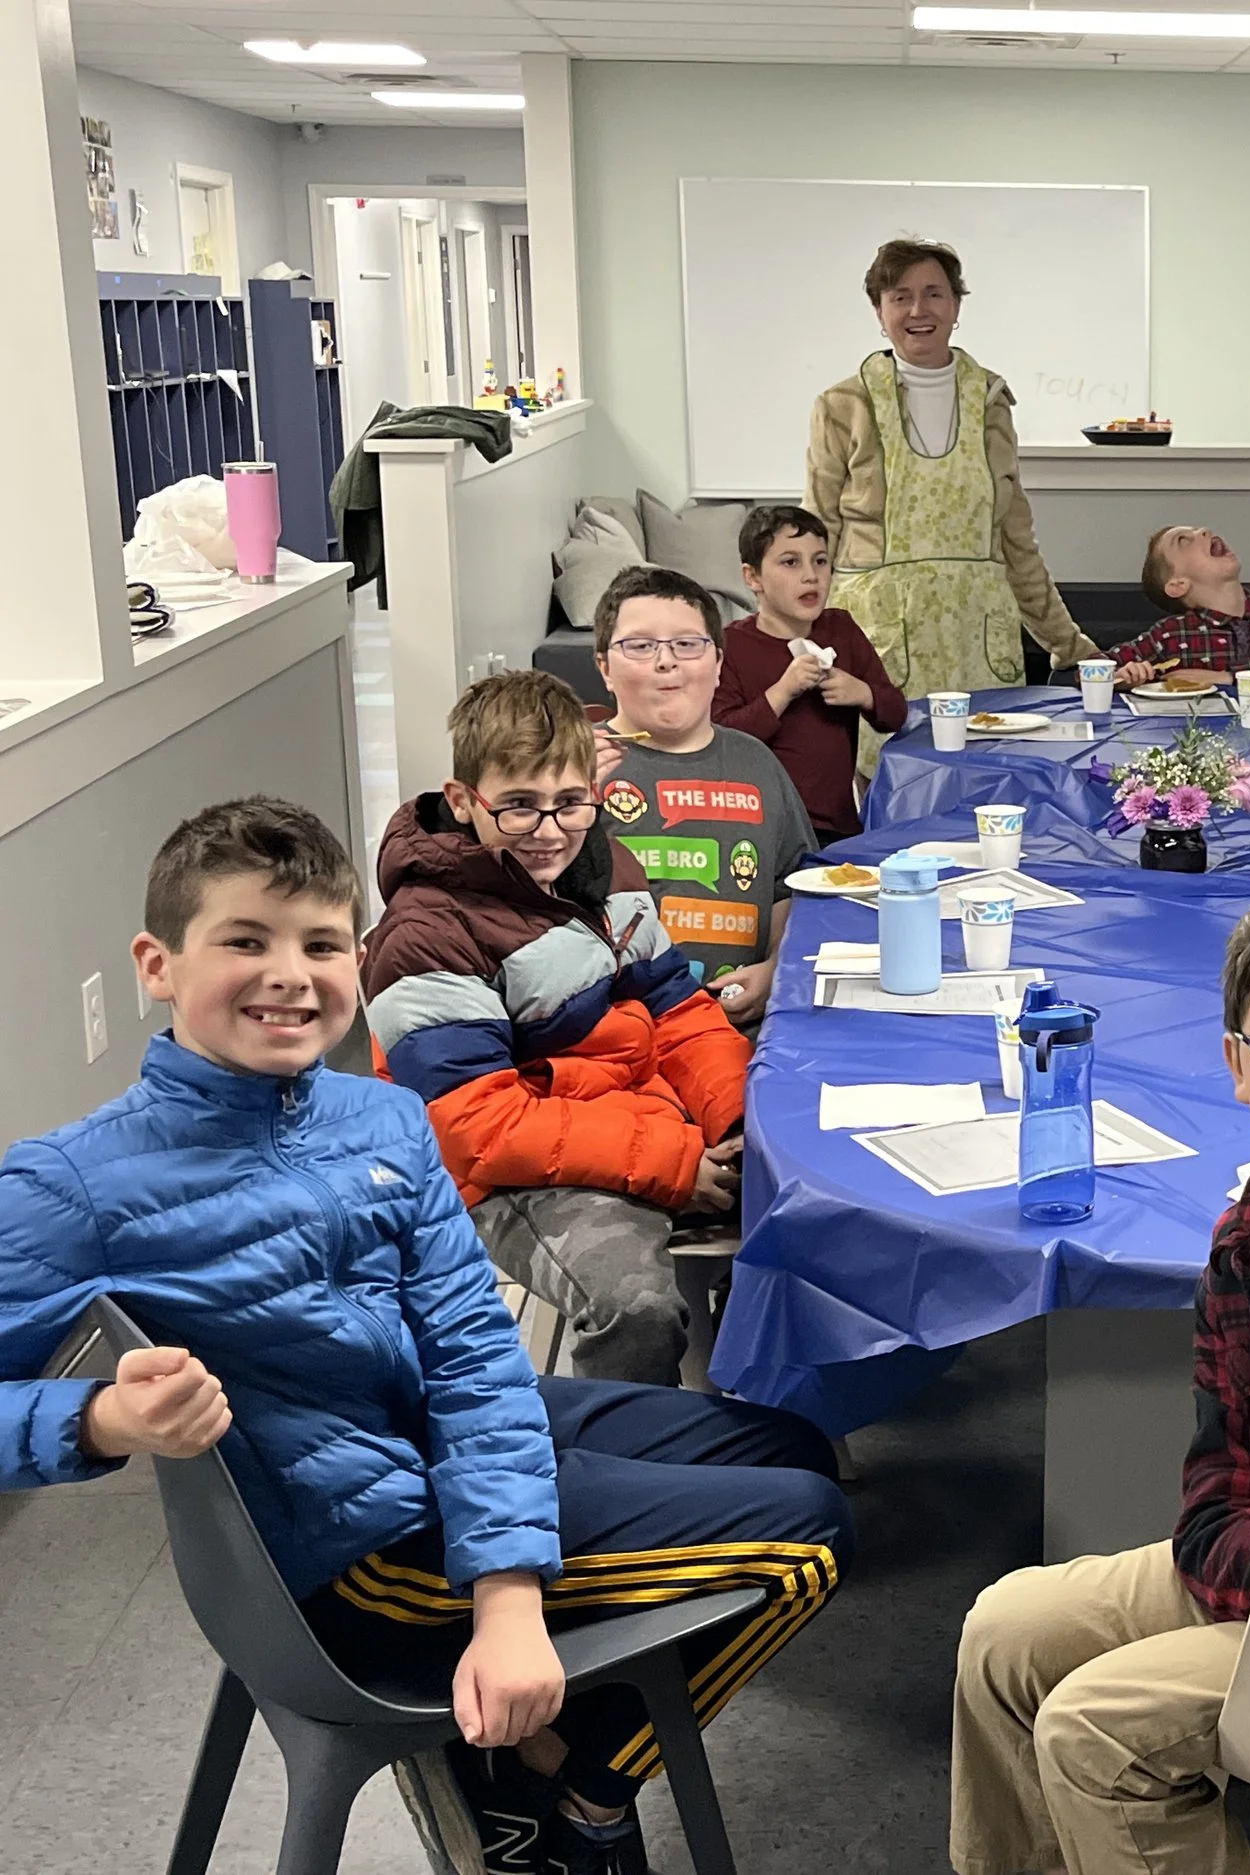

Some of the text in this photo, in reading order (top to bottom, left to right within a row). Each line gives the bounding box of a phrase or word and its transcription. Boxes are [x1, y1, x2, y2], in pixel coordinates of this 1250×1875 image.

[662, 790, 760, 811] THE HERO
[666, 850, 708, 869] BRO
[664, 909, 706, 929] THE
